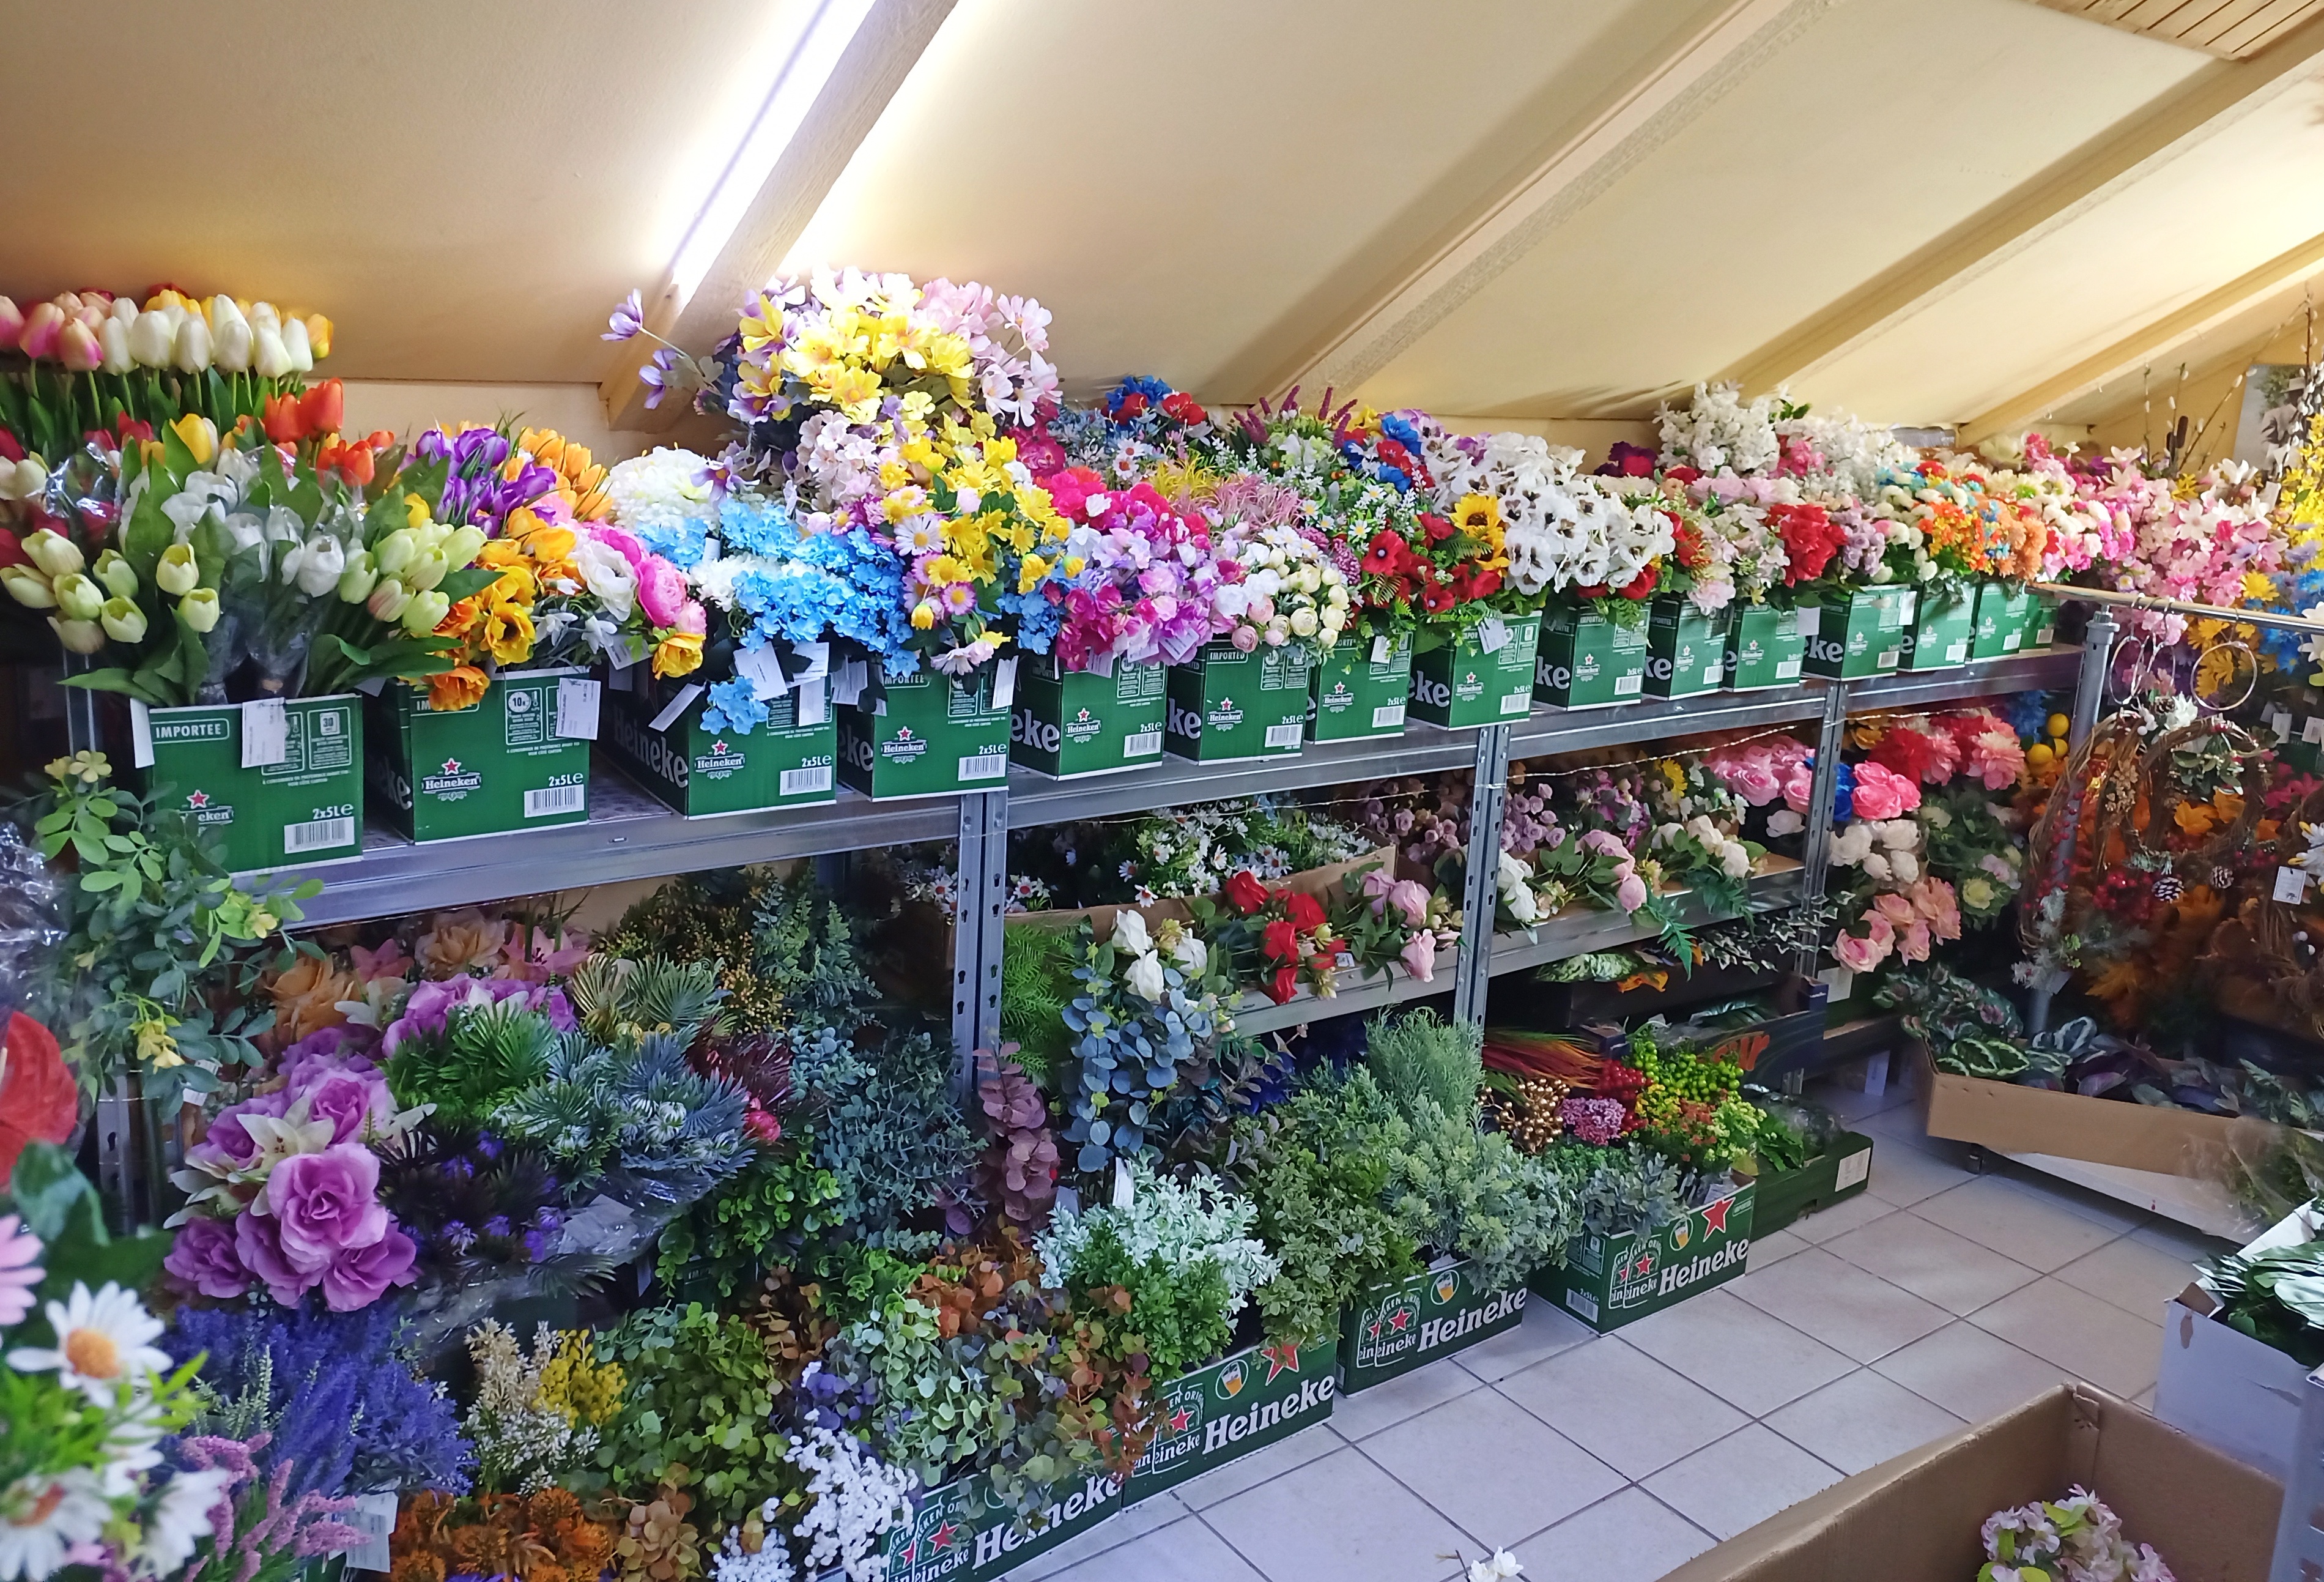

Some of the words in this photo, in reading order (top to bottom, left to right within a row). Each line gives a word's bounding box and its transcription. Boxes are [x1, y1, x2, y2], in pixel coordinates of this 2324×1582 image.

[1210, 652, 1245, 661] IMPORTED
[885, 675, 924, 684] MPORTEE
[156, 723, 221, 738] IMPORTEE
[1067, 724, 1099, 733] Heineken
[884, 744, 924, 753] Heineken
[698, 759, 742, 769] Heineken
[425, 776, 478, 790] Heineken
[972, 1476, 1121, 1570] Heneke
